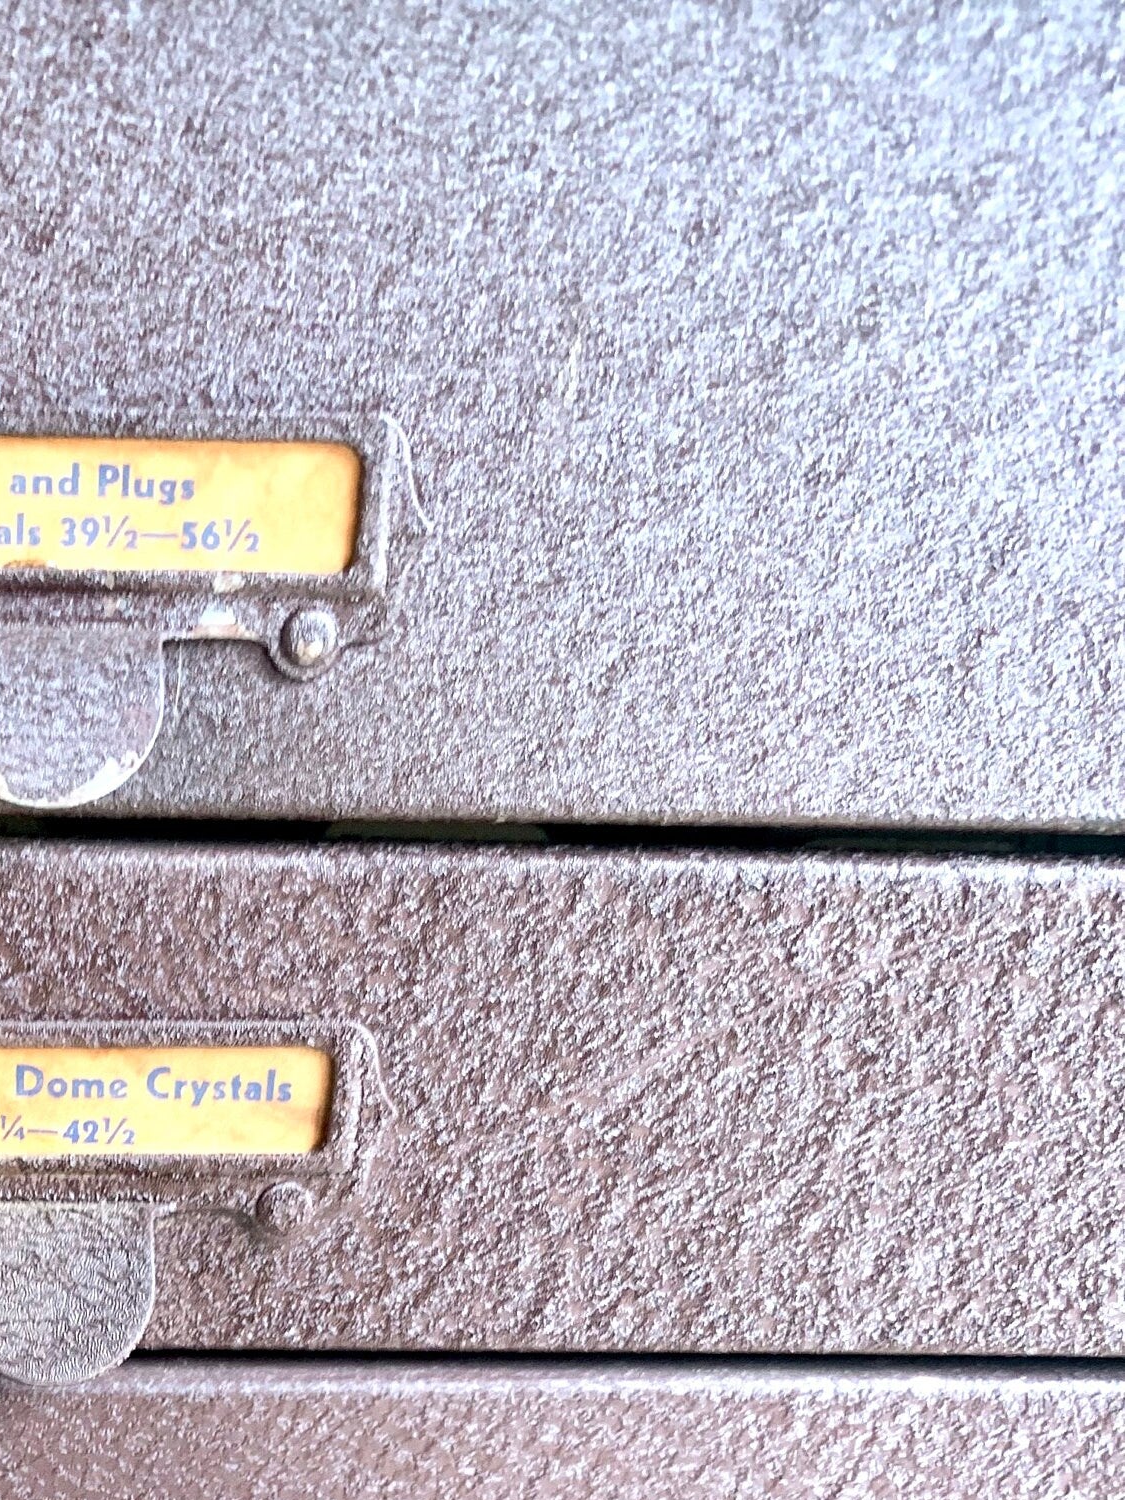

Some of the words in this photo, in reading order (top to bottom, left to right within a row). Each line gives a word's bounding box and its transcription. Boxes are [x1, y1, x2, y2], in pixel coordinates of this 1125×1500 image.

[9, 462, 81, 496] and
[97, 463, 195, 506] Plugs
[15, 1064, 128, 1099] Dome
[146, 1065, 292, 1107] Crystals
